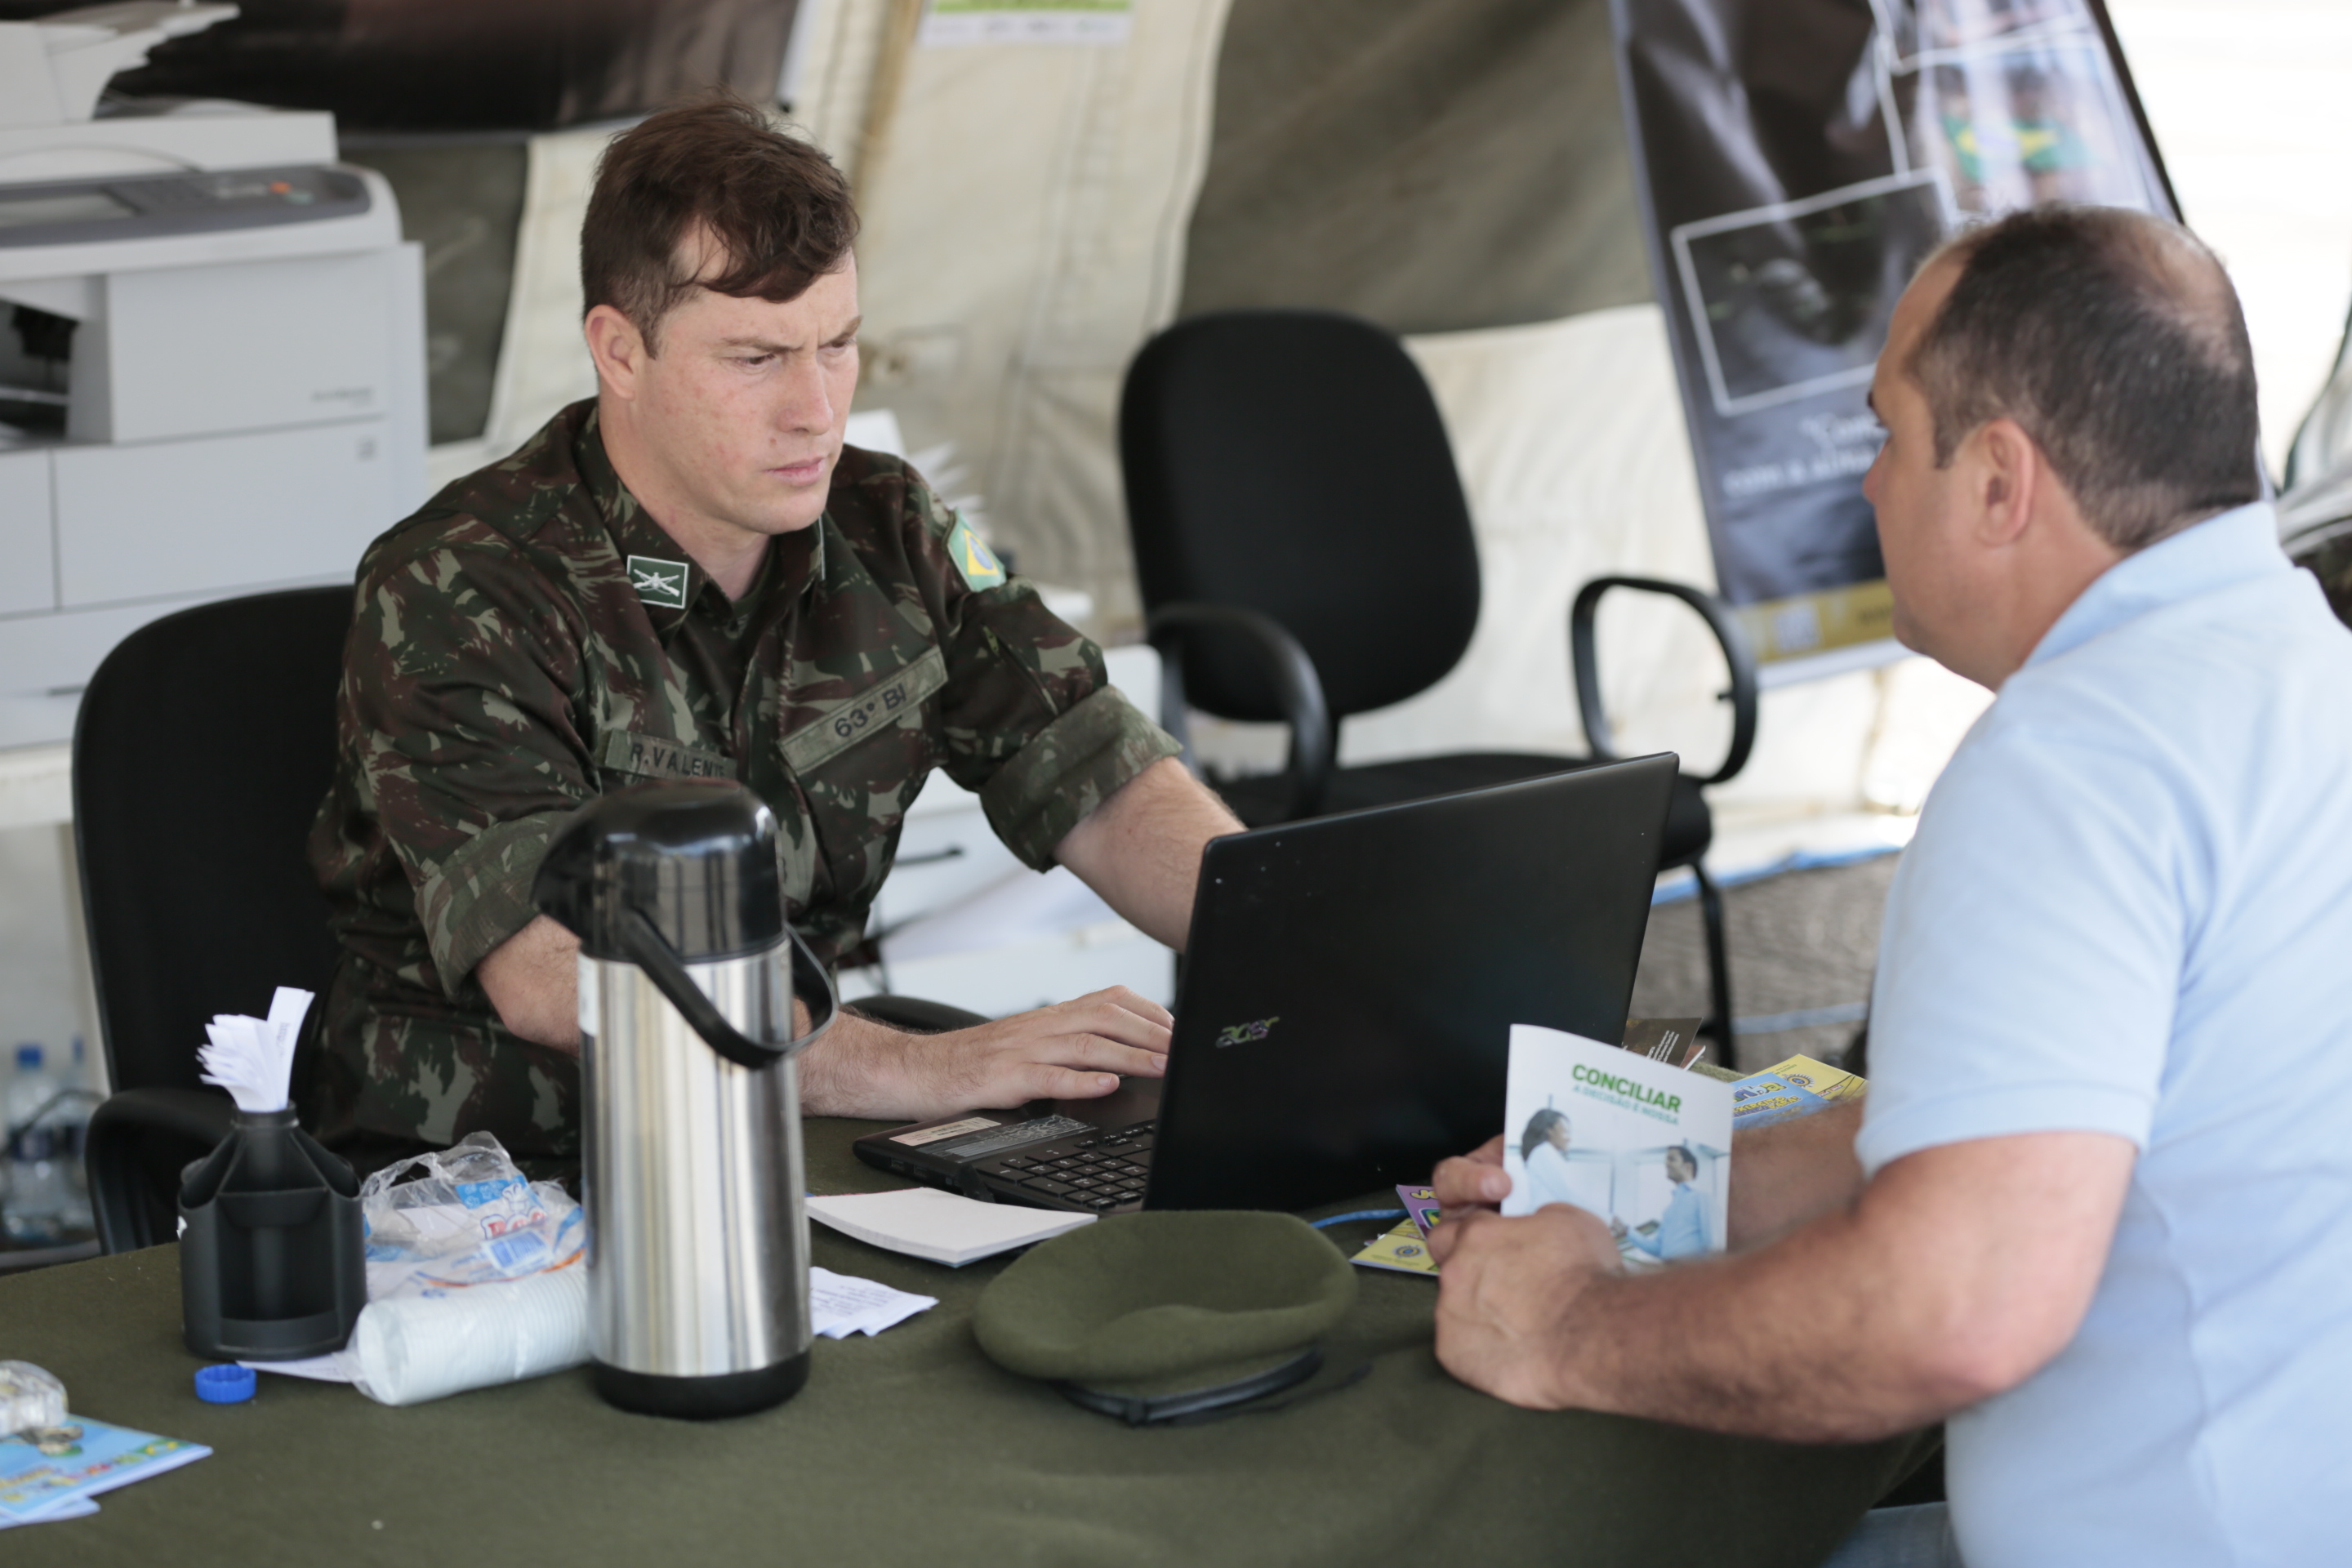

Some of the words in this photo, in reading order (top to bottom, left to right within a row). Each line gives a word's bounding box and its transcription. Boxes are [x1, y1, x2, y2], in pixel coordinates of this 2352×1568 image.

[881, 683, 906, 710] BI
[1215, 1016, 1280, 1048] acer
[1572, 1064, 1682, 1112] CONCILIAR
